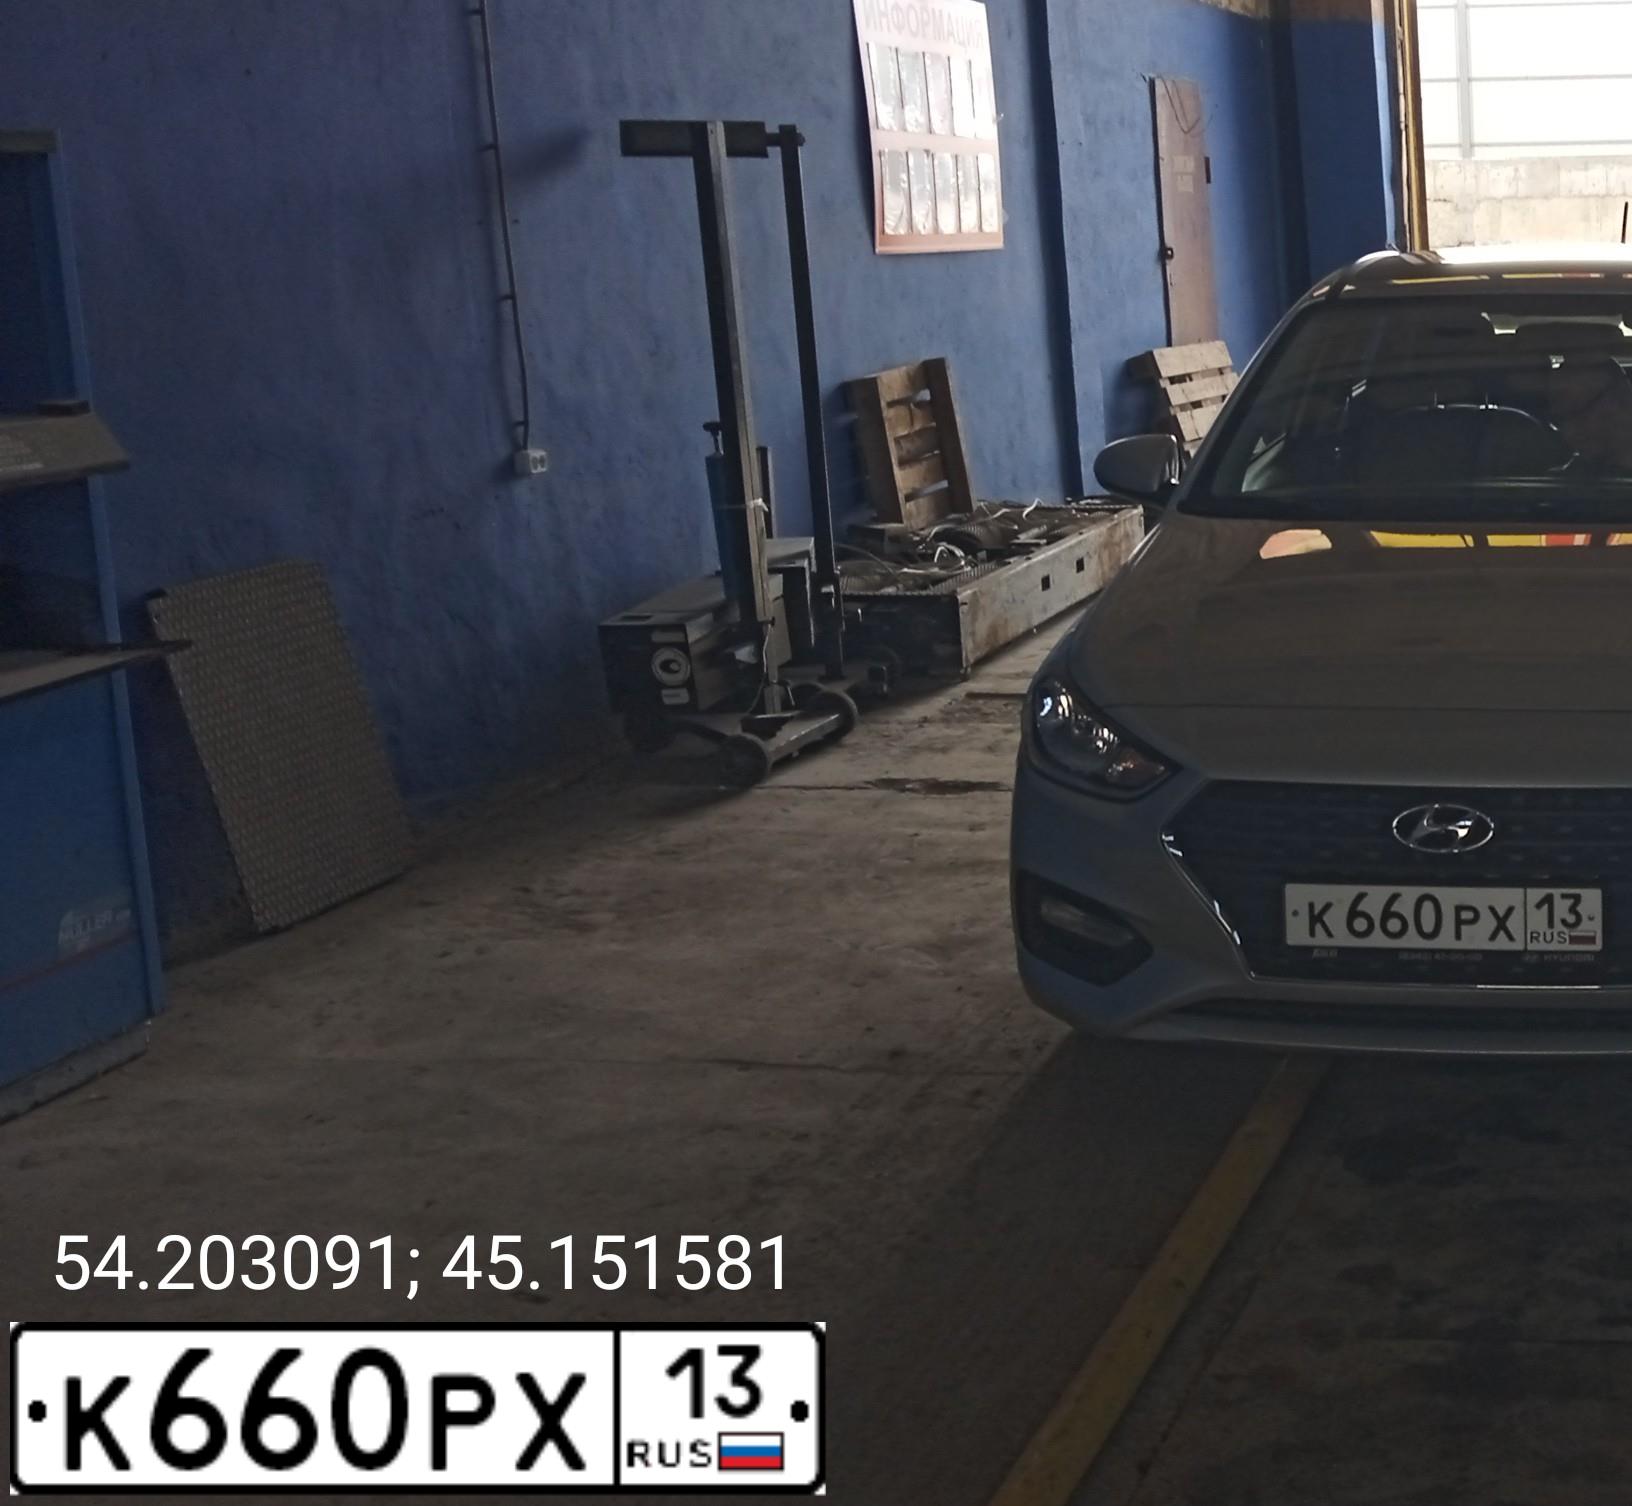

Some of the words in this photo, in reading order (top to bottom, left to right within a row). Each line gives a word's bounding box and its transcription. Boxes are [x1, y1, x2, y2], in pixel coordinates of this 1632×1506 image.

[863, 0, 985, 50] ИНФОРМАЦИЯ
[1533, 893, 1583, 931] 13
[1529, 930, 1567, 944] RUS
